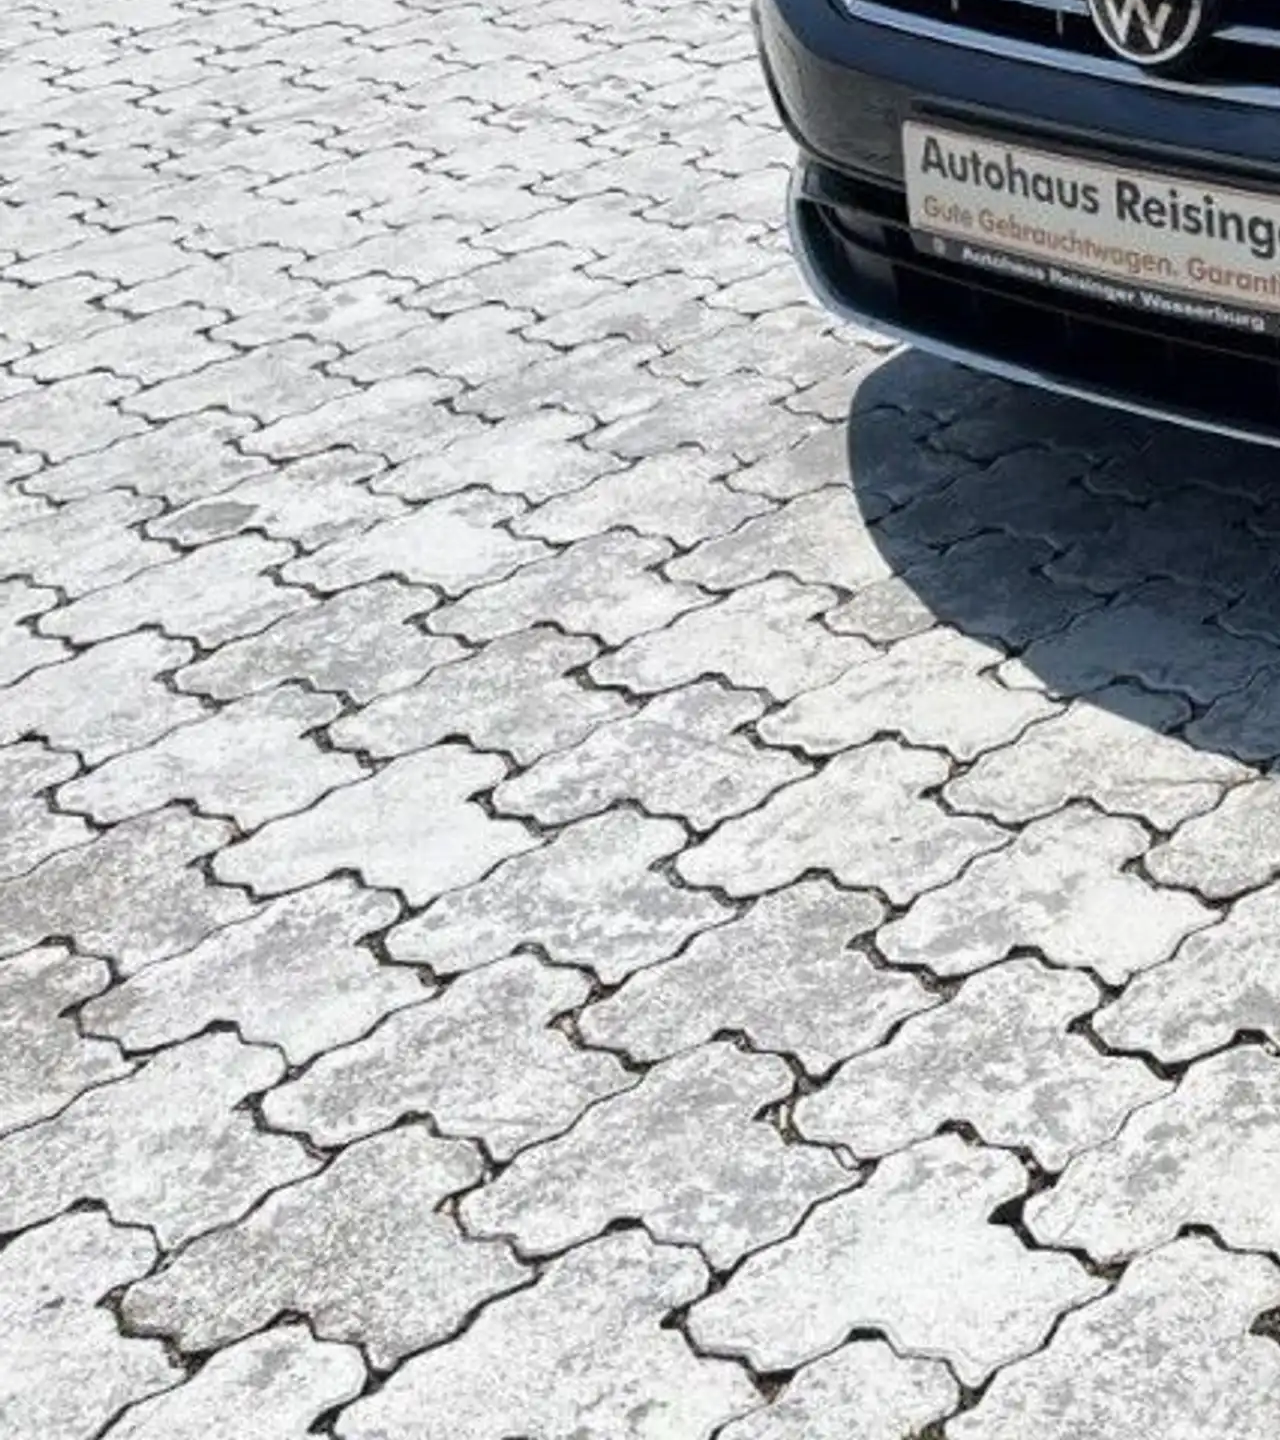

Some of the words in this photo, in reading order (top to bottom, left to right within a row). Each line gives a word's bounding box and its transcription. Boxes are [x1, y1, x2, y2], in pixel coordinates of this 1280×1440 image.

[921, 135, 1100, 214] Autohaus
[923, 194, 973, 227] Gute
[978, 208, 1178, 275] Gebrauchtwagen.
